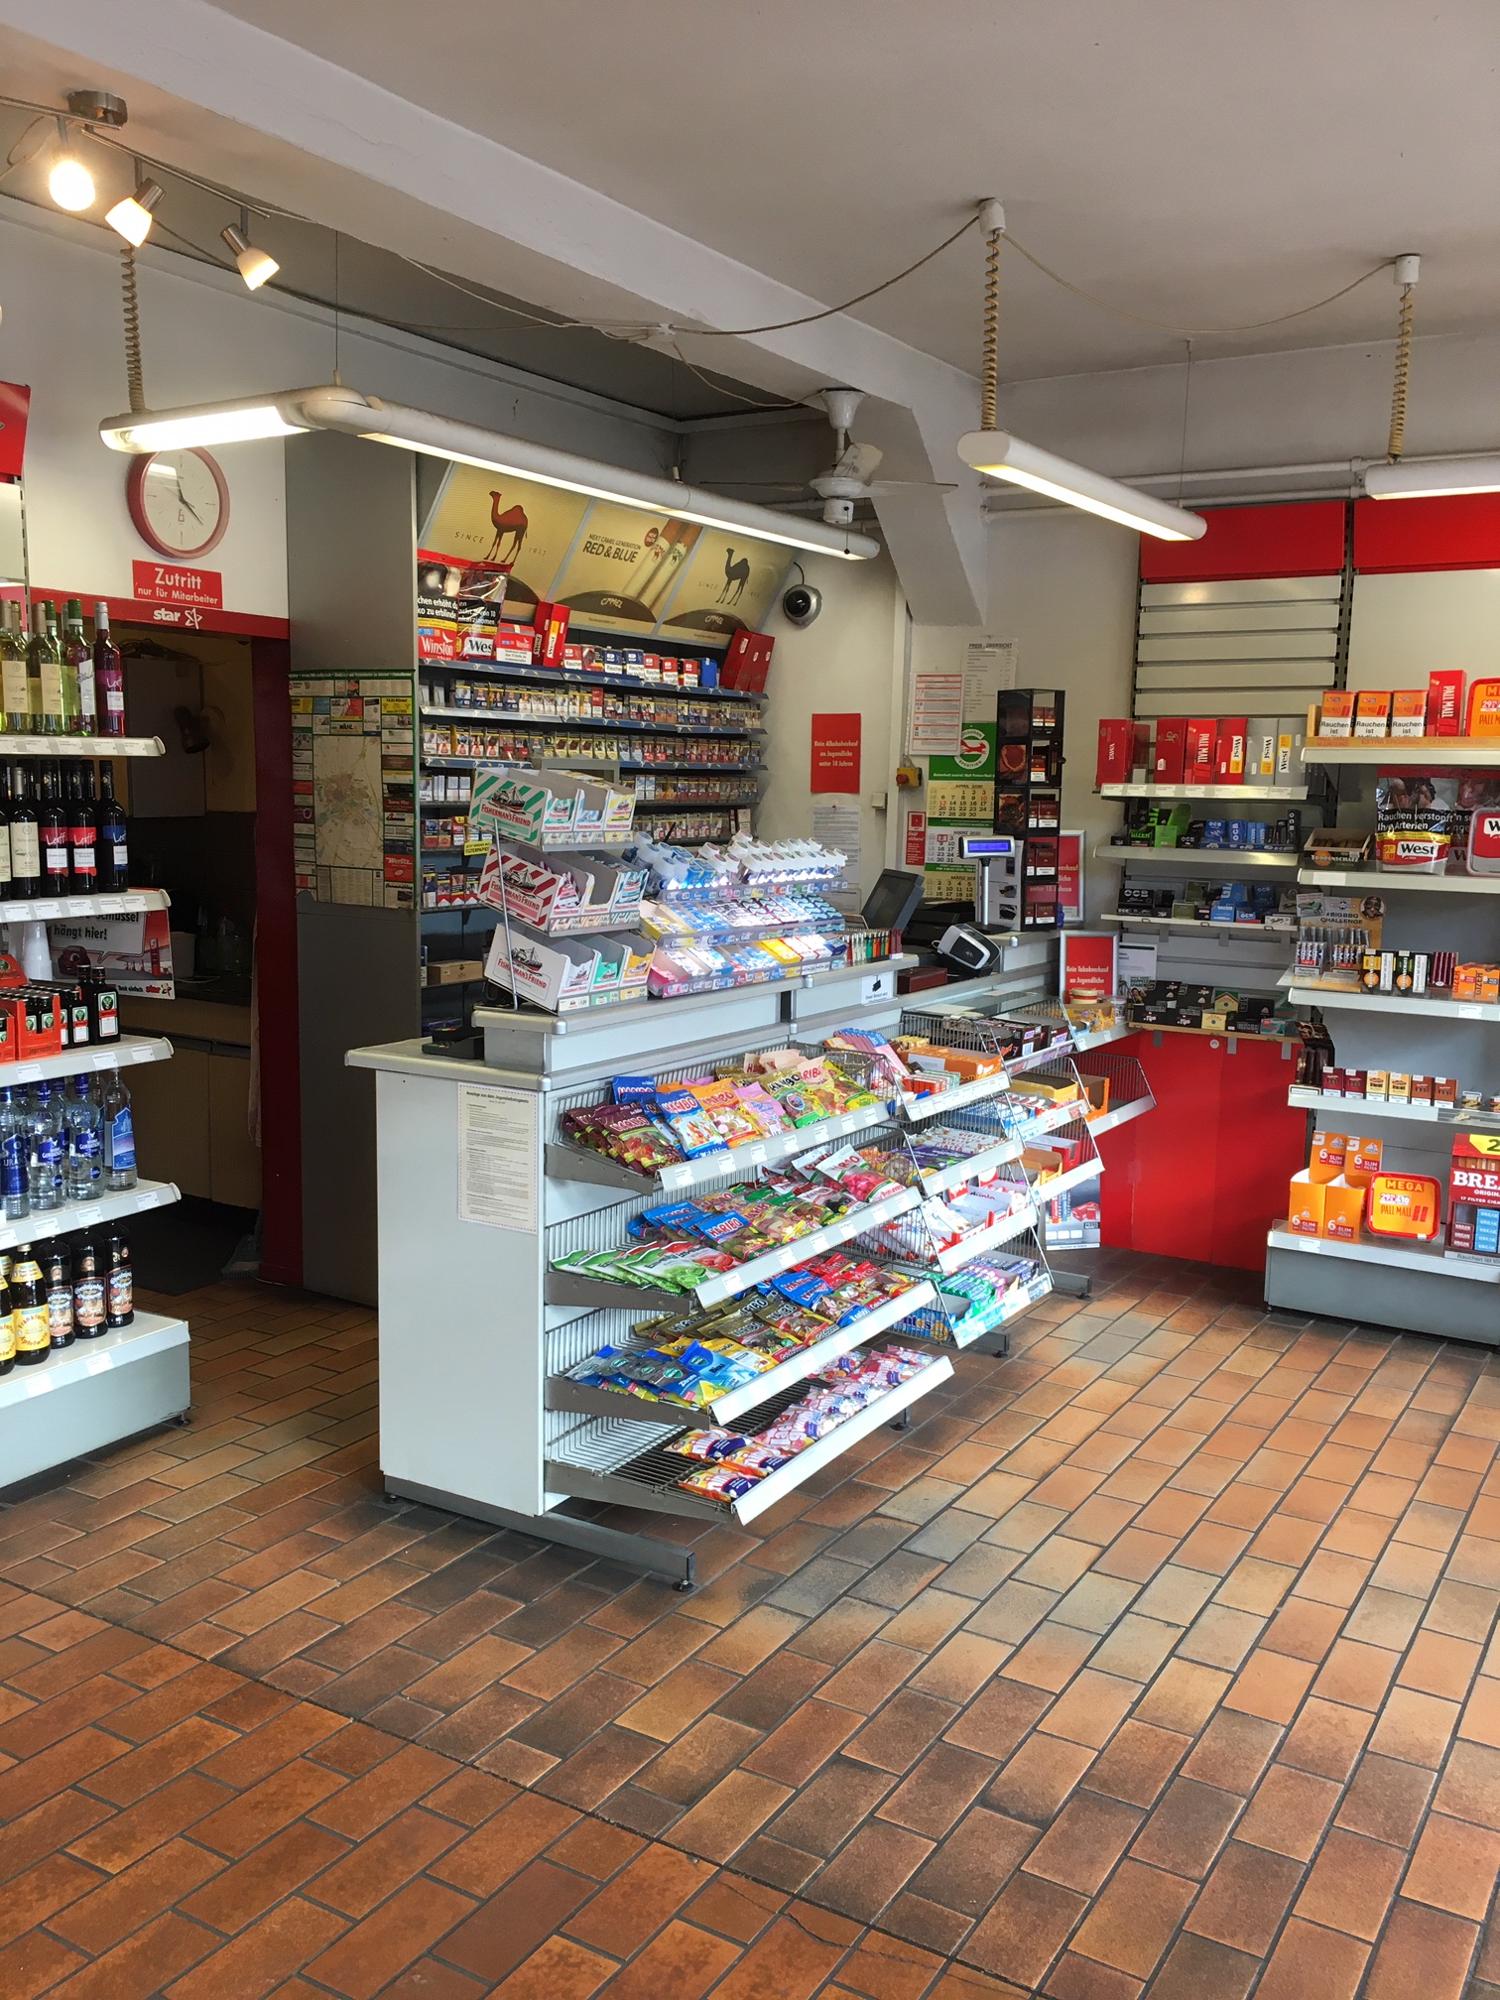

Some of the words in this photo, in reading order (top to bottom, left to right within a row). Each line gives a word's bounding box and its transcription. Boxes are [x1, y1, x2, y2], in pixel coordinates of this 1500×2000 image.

[454, 531, 485, 544] SINCE
[582, 541, 604, 556] RED
[604, 546, 613, 558] &
[612, 547, 638, 564] BLUE
[154, 567, 202, 590] Zutritt
[137, 587, 153, 596] nur
[156, 587, 168, 598] für
[172, 590, 218, 605] Mitarbeiter
[153, 607, 181, 622] star
[435, 608, 457, 619] erblinde
[420, 636, 454, 657] Winston
[468, 638, 493, 654] Wes
[1442, 685, 1455, 702] PALL
[1442, 701, 1455, 718] MALL
[1321, 721, 1349, 729] Rauchen
[1330, 727, 1339, 735] ist
[1365, 727, 1374, 735] ist
[1198, 733, 1209, 747] PALL
[1233, 735, 1242, 758] West
[1198, 747, 1209, 763] MALL
[1264, 736, 1273, 760] West
[1279, 749, 1289, 772] West
[481, 804, 512, 822] FISHERMAN'S
[511, 814, 531, 827] FRIEND
[1378, 812, 1412, 821] Rauchen
[1394, 823, 1428, 831] Arterien
[1401, 843, 1435, 855] West
[1124, 889, 1149, 898] OCB
[521, 897, 540, 911] FRIEND
[54, 924, 83, 939] hängt
[84, 926, 108, 940] hier!
[528, 974, 547, 990] FRIEND
[662, 1096, 698, 1113] HARIBO
[1320, 1149, 1328, 1159] 6
[1354, 1155, 1363, 1165] 6
[1387, 1181, 1423, 1191] MEGA
[1380, 1205, 1395, 1215] PALL
[1395, 1205, 1412, 1217] MALL
[1292, 1215, 1300, 1225] 6
[1328, 1220, 1336, 1230] 6
[708, 1217, 744, 1238] HARIBO
